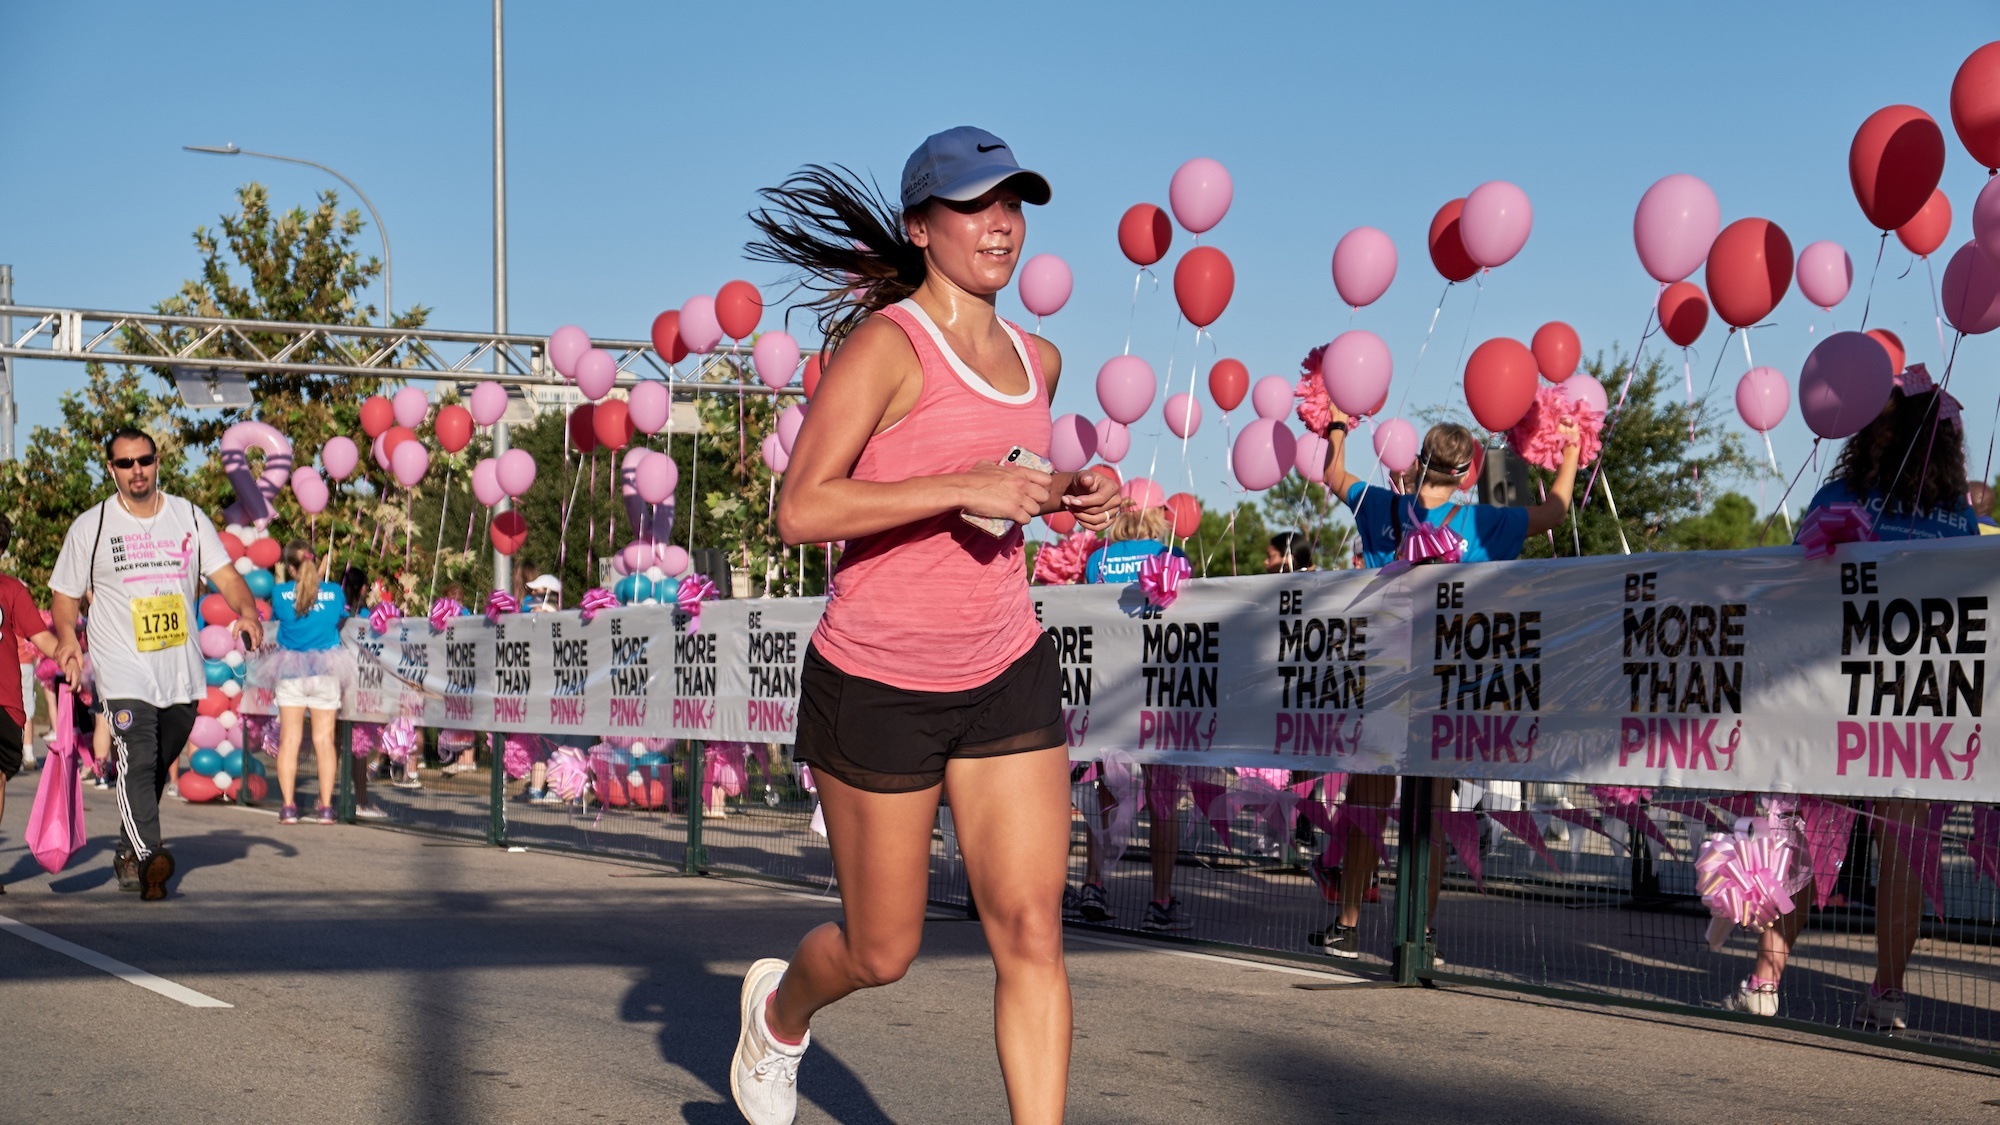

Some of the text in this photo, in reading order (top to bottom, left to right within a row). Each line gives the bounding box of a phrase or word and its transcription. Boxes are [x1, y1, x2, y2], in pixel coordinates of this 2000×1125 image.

[110, 533, 152, 544] BE BOLD
[1880, 523, 1911, 534] American
[112, 540, 176, 554] BE FEARLESS
[113, 551, 156, 563] BE MORE
[114, 563, 134, 572] RACE
[1840, 562, 1878, 595] BE
[1436, 582, 1465, 609] BE
[1624, 572, 1657, 602] BE
[1034, 601, 1042, 622] E
[1279, 590, 1302, 616] BE
[142, 612, 178, 634] 1738
[446, 626, 454, 640] BE
[496, 623, 505, 639] BE
[552, 622, 561, 638] BE
[610, 618, 622, 635] BE
[674, 614, 686, 632] BE
[748, 612, 762, 630] BE
[1434, 611, 1542, 660] MORE
[1623, 604, 1747, 658] MORE
[1841, 596, 1988, 656] MORE
[552, 640, 588, 667] MORE
[611, 636, 649, 665] MORE
[674, 634, 716, 664] MORE
[748, 632, 796, 664] MORE
[1142, 622, 1220, 664] MORE
[1278, 617, 1368, 662] MORE
[399, 644, 428, 667] MORE
[446, 643, 476, 668] MORE
[495, 642, 530, 668] MORE
[358, 666, 384, 689] THAN
[446, 670, 476, 694] THAN
[496, 670, 530, 696] THAN
[554, 669, 588, 696] THAN
[610, 667, 648, 696] THAN
[674, 666, 716, 696] THAN
[748, 666, 796, 698] THAN
[1061, 668, 1092, 706] AN
[1142, 667, 1218, 708] THAN
[1278, 666, 1366, 709] THAN
[1434, 663, 1540, 711] THAN
[1623, 662, 1744, 714] THAN
[1840, 660, 1984, 717] THAN
[444, 696, 468, 720] PINK
[494, 698, 521, 723] PINK
[550, 698, 578, 725] PINK
[610, 698, 638, 727] PINK
[672, 698, 707, 729] PINK
[748, 700, 788, 732] PINK
[1138, 710, 1201, 752] PINK
[1274, 712, 1347, 758] PINK
[1431, 714, 1520, 764] PINK
[1618, 718, 1720, 771] PINK
[1836, 720, 1955, 780] PINK
